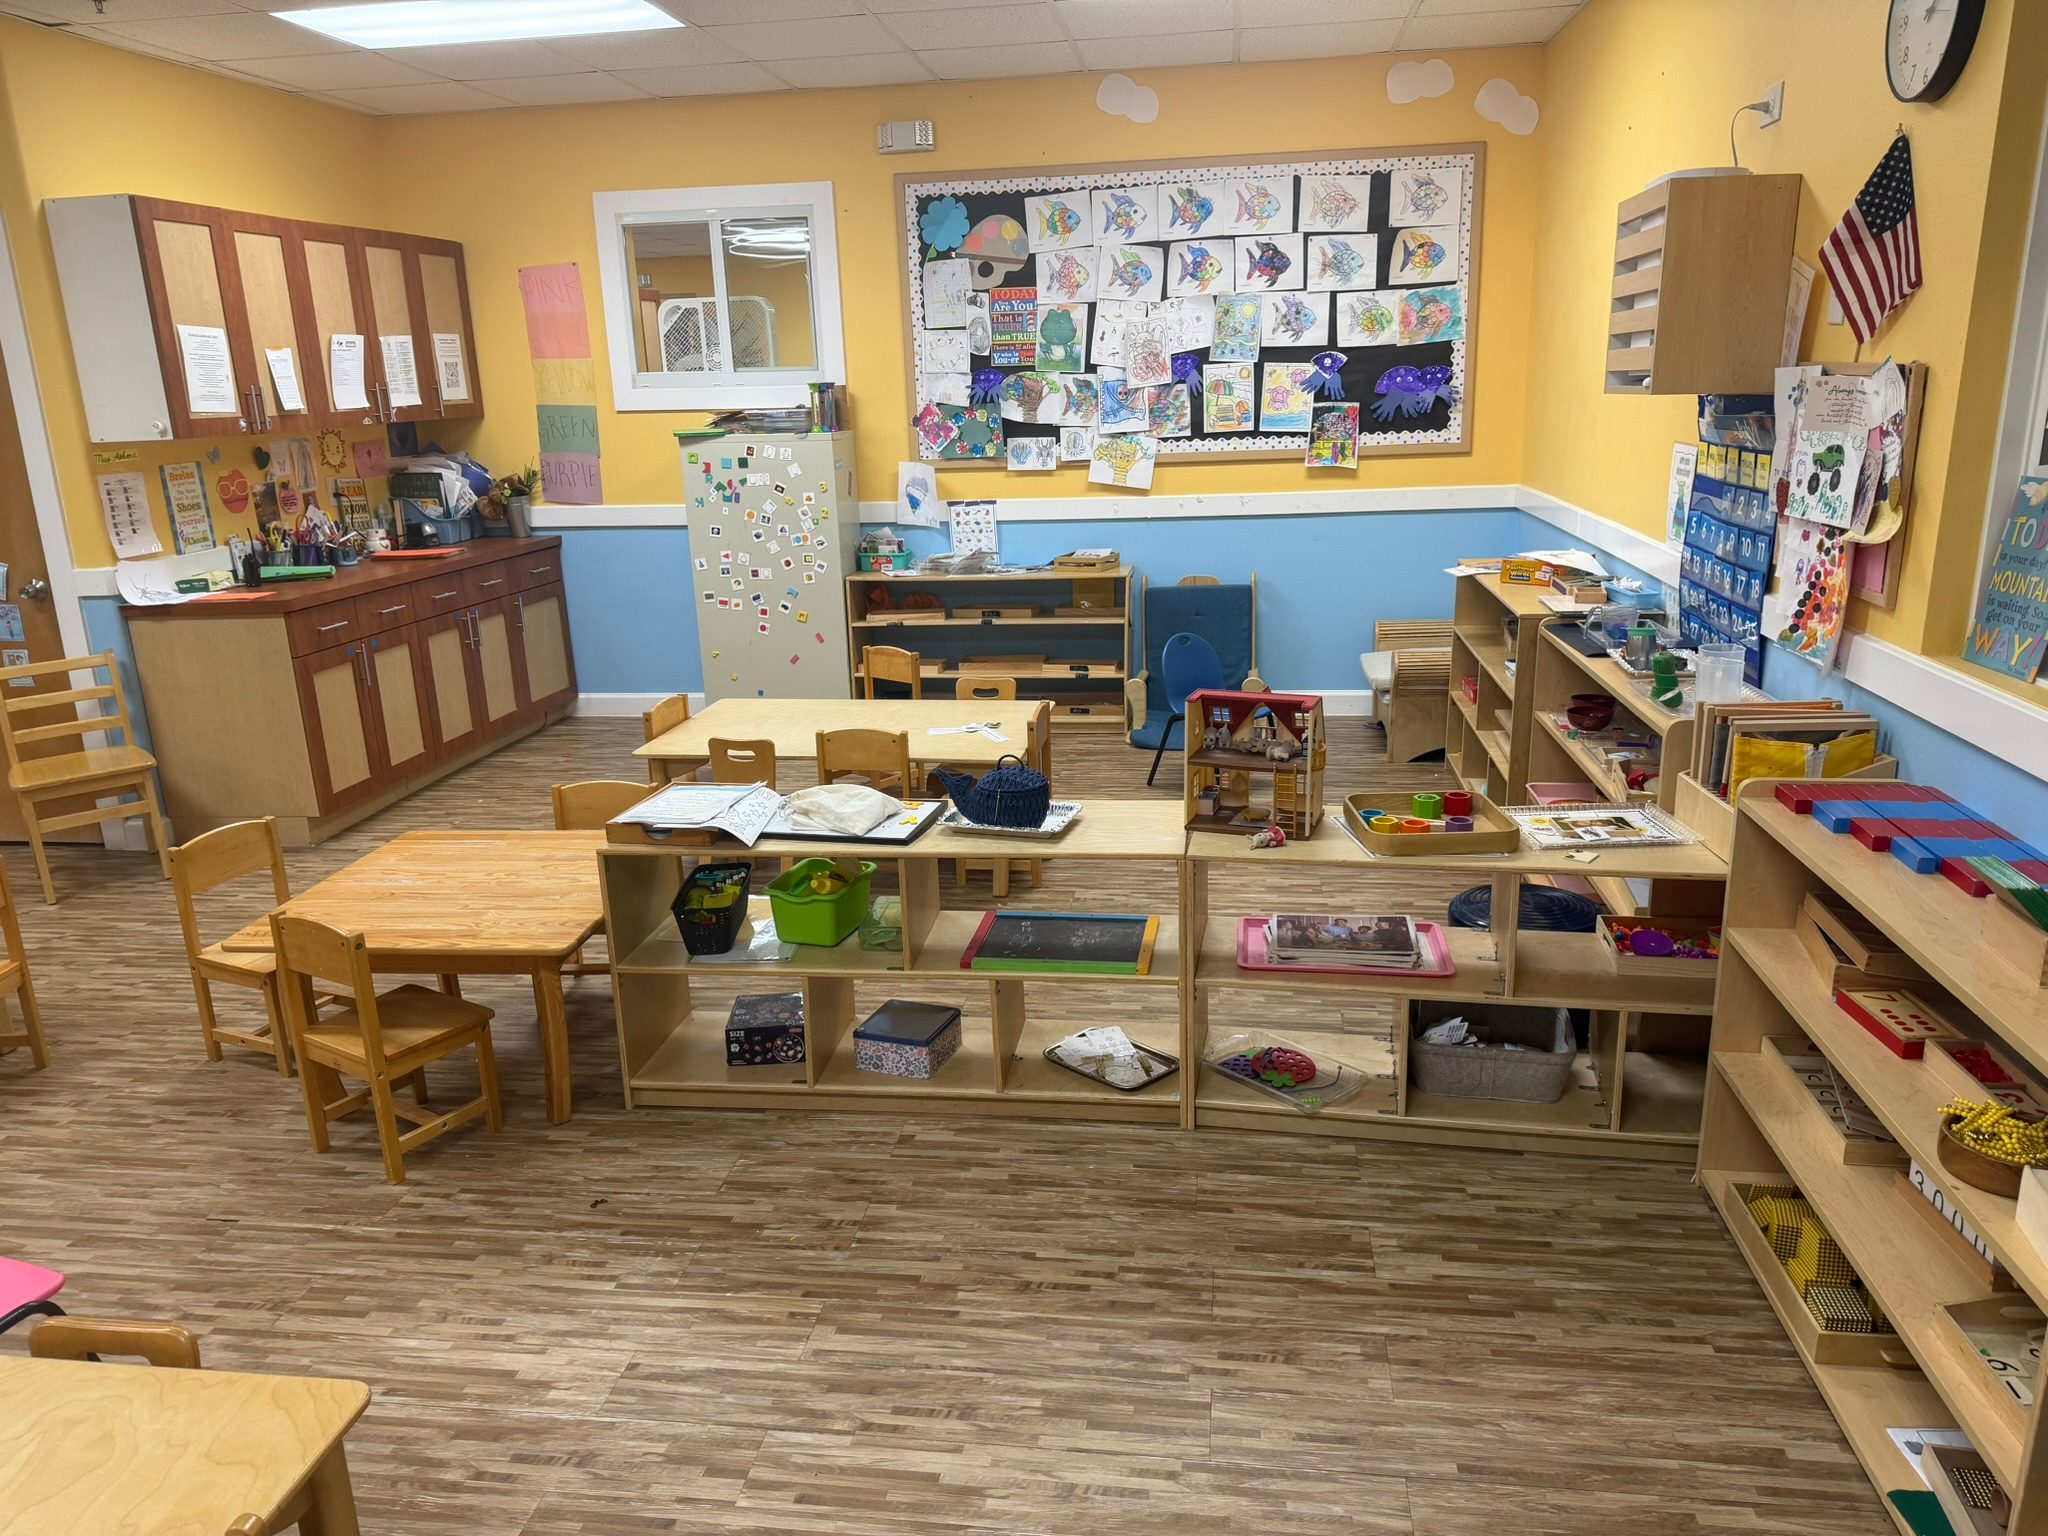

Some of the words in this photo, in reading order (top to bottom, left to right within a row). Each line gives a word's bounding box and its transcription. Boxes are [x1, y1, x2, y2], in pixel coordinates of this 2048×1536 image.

[1903, 15, 1909, 32] 9
[1903, 46, 1909, 63] 8
[1911, 64, 1917, 82] 7
[1923, 67, 1928, 85] 6
[520, 273, 580, 306] PINK
[992, 289, 1037, 300] TODAY
[993, 302, 1011, 312] Are
[992, 314, 1013, 323] That
[1015, 314, 1023, 322] is
[992, 322, 1022, 331] TRUER
[993, 333, 1010, 341] than
[540, 415, 595, 442] GREEN
[168, 470, 195, 482] Brains
[820, 480, 828, 493] 3
[821, 507, 828, 519] 2
[1737, 496, 1744, 515] 2
[1750, 500, 1758, 519] 3
[1765, 505, 1772, 523] 4
[1690, 518, 1696, 534] 5
[1702, 522, 1706, 538] 6
[1710, 527, 1715, 543] 7
[1742, 537, 1751, 557] 10
[1758, 543, 1765, 562] 11
[2000, 552, 2008, 560] is
[2009, 554, 2028, 565] your
[1693, 555, 1700, 574] 13
[1704, 560, 1712, 578] 14
[1714, 564, 1720, 583] 15
[1724, 570, 1730, 589] 16
[1736, 574, 1746, 594] 17
[1751, 580, 1760, 598] 18
[1987, 594, 1996, 606] is
[1720, 606, 1728, 624] 23
[1732, 614, 1742, 633] 24
[1985, 609, 2001, 624] get
[2003, 616, 2014, 626] on
[2015, 618, 2040, 632] your
[1690, 622, 1698, 640] 27
[1975, 624, 2042, 670] WAY!
